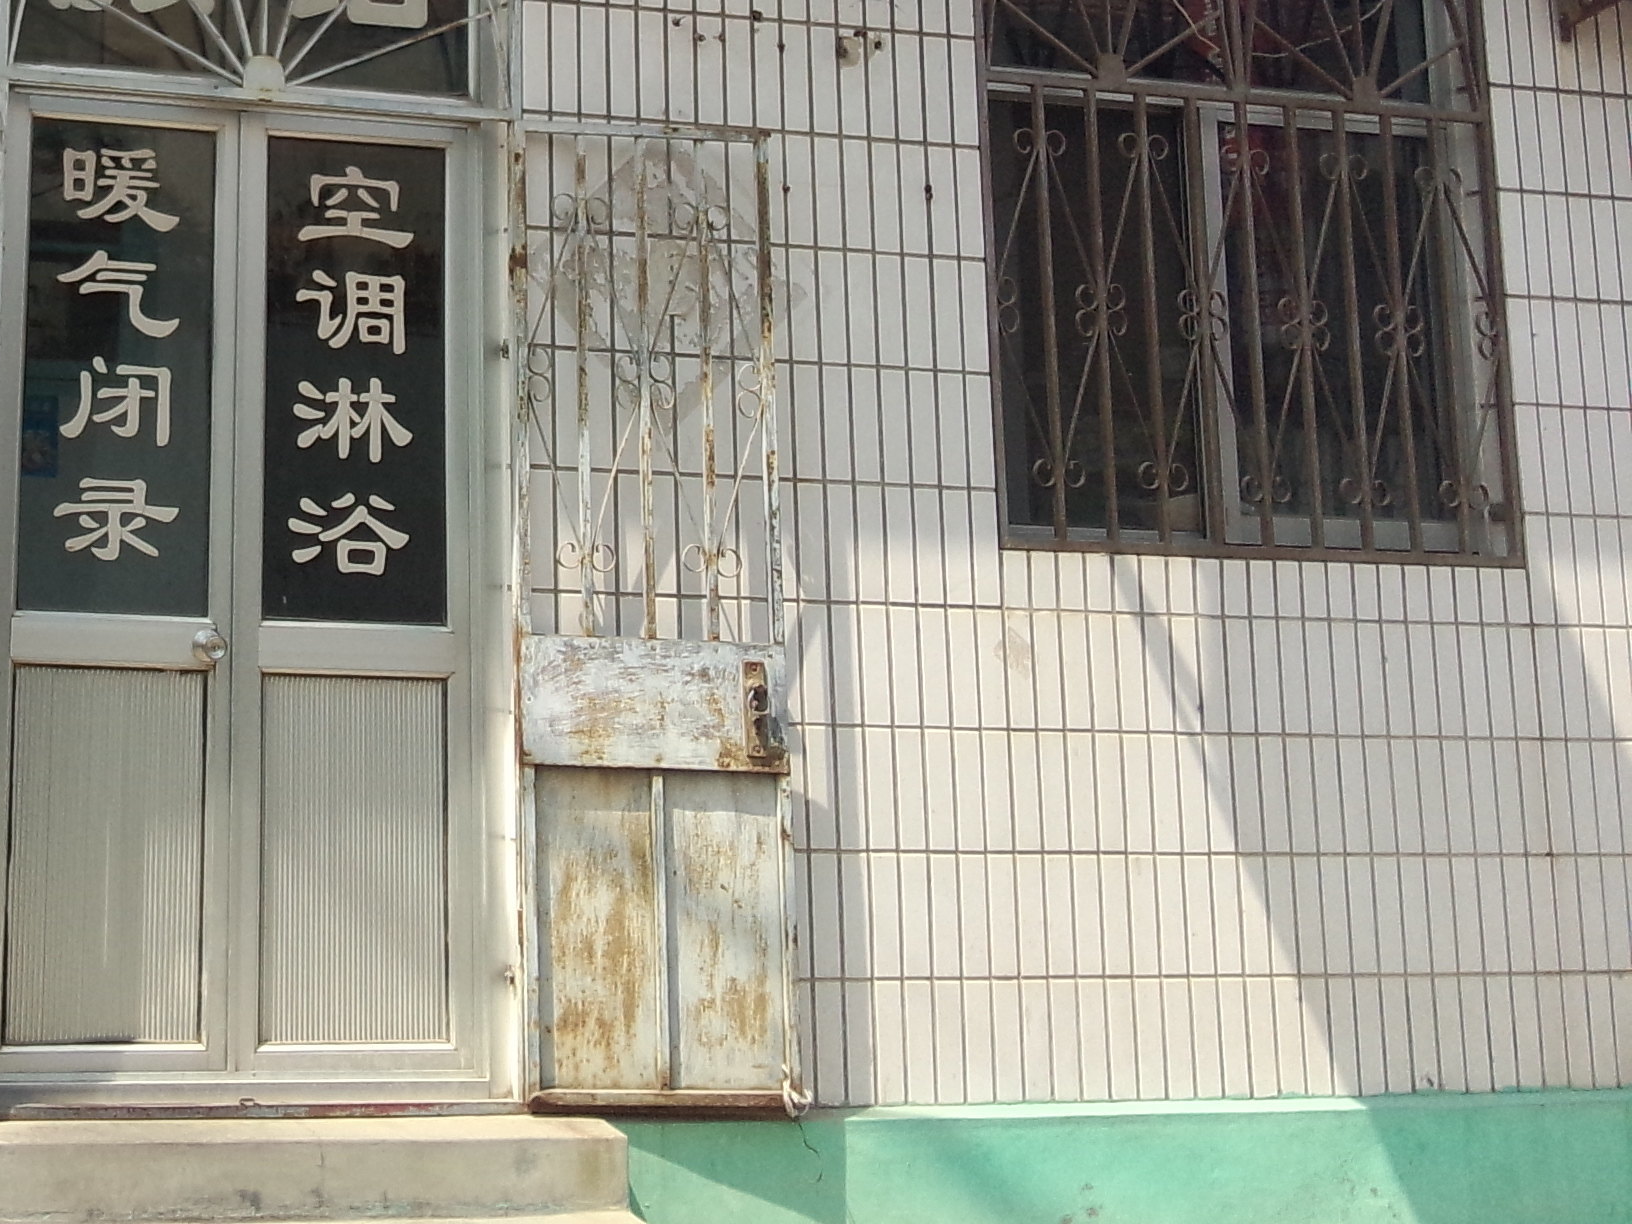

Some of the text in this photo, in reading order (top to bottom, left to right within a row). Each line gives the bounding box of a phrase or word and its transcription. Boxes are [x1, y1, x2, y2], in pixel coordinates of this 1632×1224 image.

[53, 146, 180, 562] 暖气闭录
[287, 166, 414, 576] 空调淋浴
